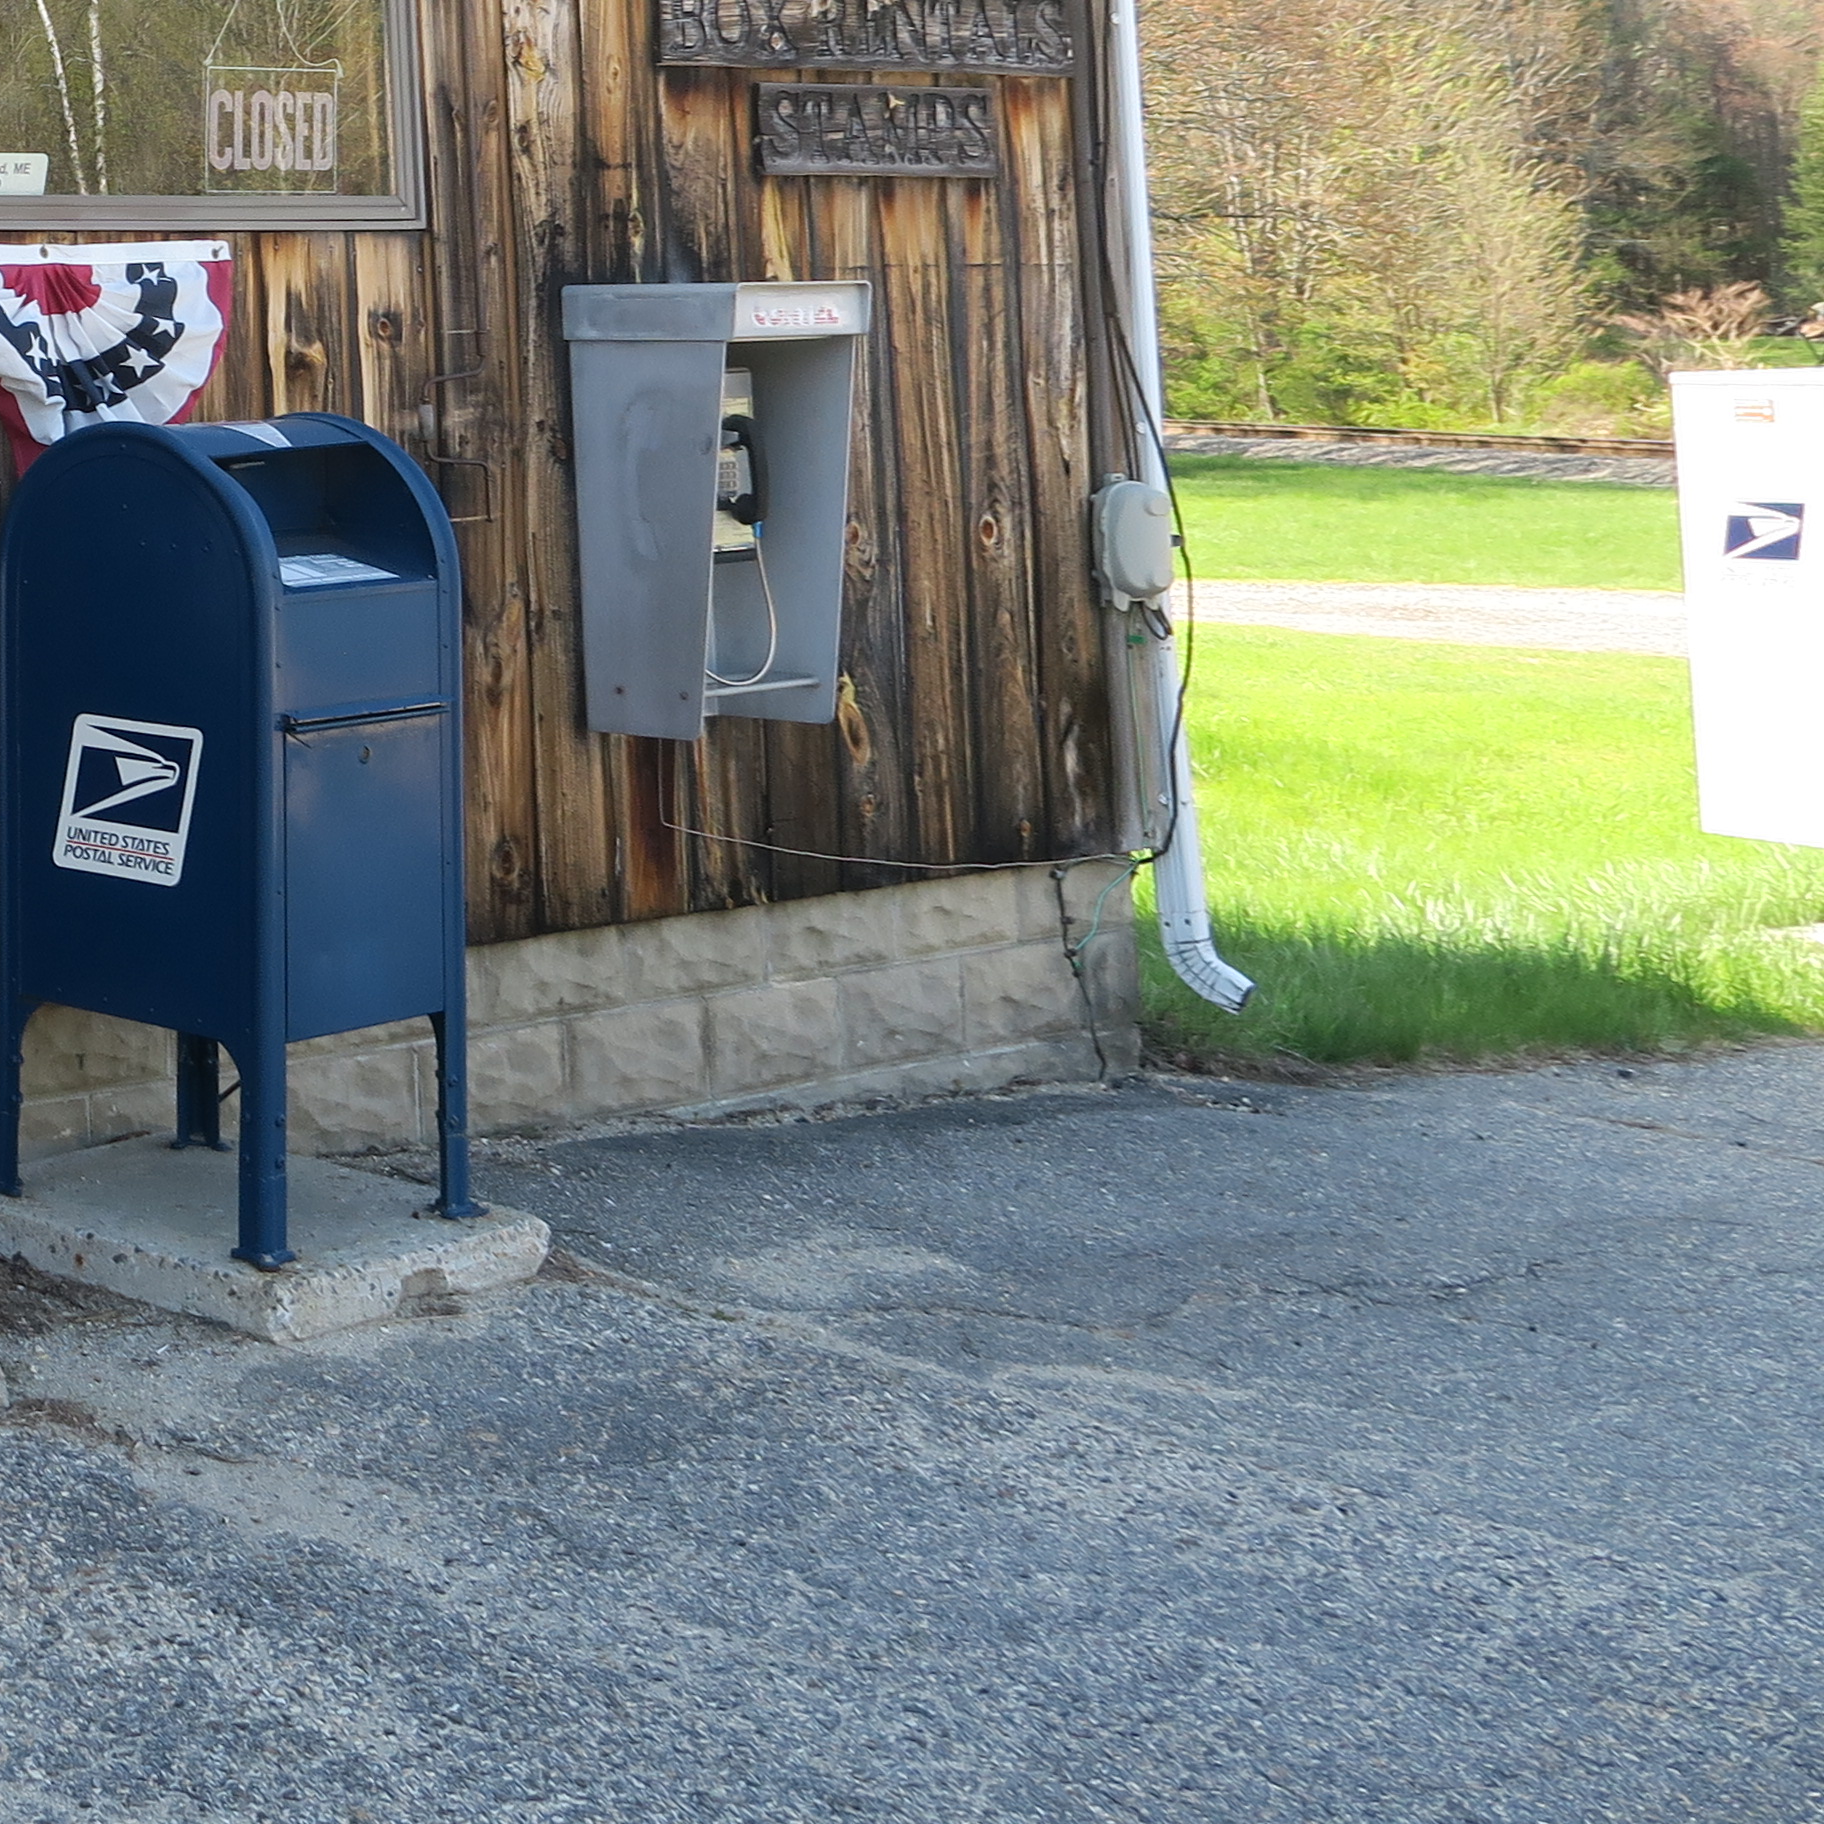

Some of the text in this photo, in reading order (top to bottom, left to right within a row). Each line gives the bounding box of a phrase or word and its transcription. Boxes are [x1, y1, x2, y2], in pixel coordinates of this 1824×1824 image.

[208, 88, 335, 172] CLOSED
[766, 90, 993, 167] STAMPS
[13, 162, 31, 174] ME
[66, 825, 171, 856] UNITED STATES
[63, 843, 175, 876] POSTAL SERVICE
